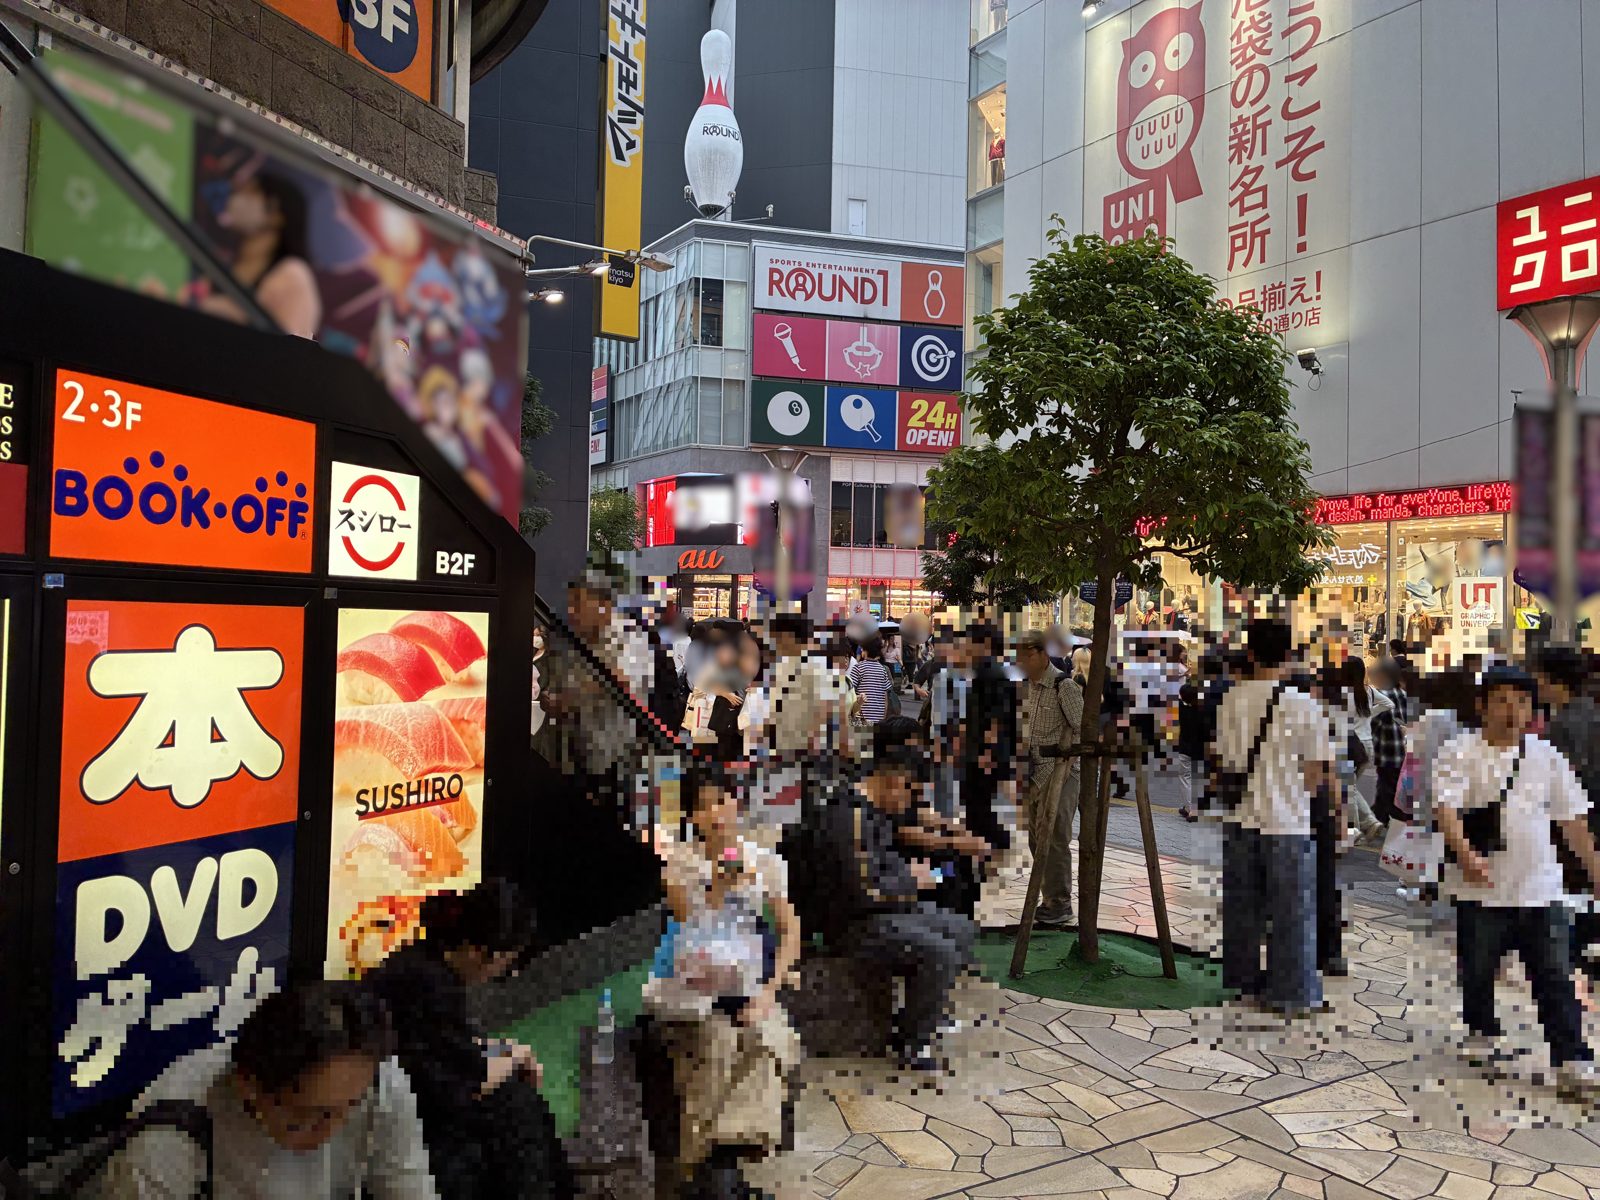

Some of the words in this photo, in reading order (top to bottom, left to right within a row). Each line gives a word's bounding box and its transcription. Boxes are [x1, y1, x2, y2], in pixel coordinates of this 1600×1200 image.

[608, 0, 646, 162] マツモトキ
[1110, 188, 1155, 229] UNI
[1512, 191, 1597, 247] ユニ
[608, 267, 634, 279] matsu
[769, 258, 803, 267] SPORTS
[806, 261, 876, 275] ENTERTAINMENT
[1509, 238, 1598, 293] クロ
[608, 274, 624, 286] kiyo
[768, 267, 889, 307] ROUND1
[907, 399, 958, 429] 24H
[905, 428, 955, 447] OPEN!
[1354, 496, 1372, 509] life
[1377, 493, 1396, 507] for
[1418, 498, 1491, 517] characters,
[335, 508, 412, 533] スシロー
[435, 550, 476, 576] B2F
[678, 549, 725, 569] au
[1460, 582, 1497, 610] UT
[80, 623, 285, 808] 本
[355, 773, 464, 816] SUSHIRO
[75, 848, 279, 980] DVD
